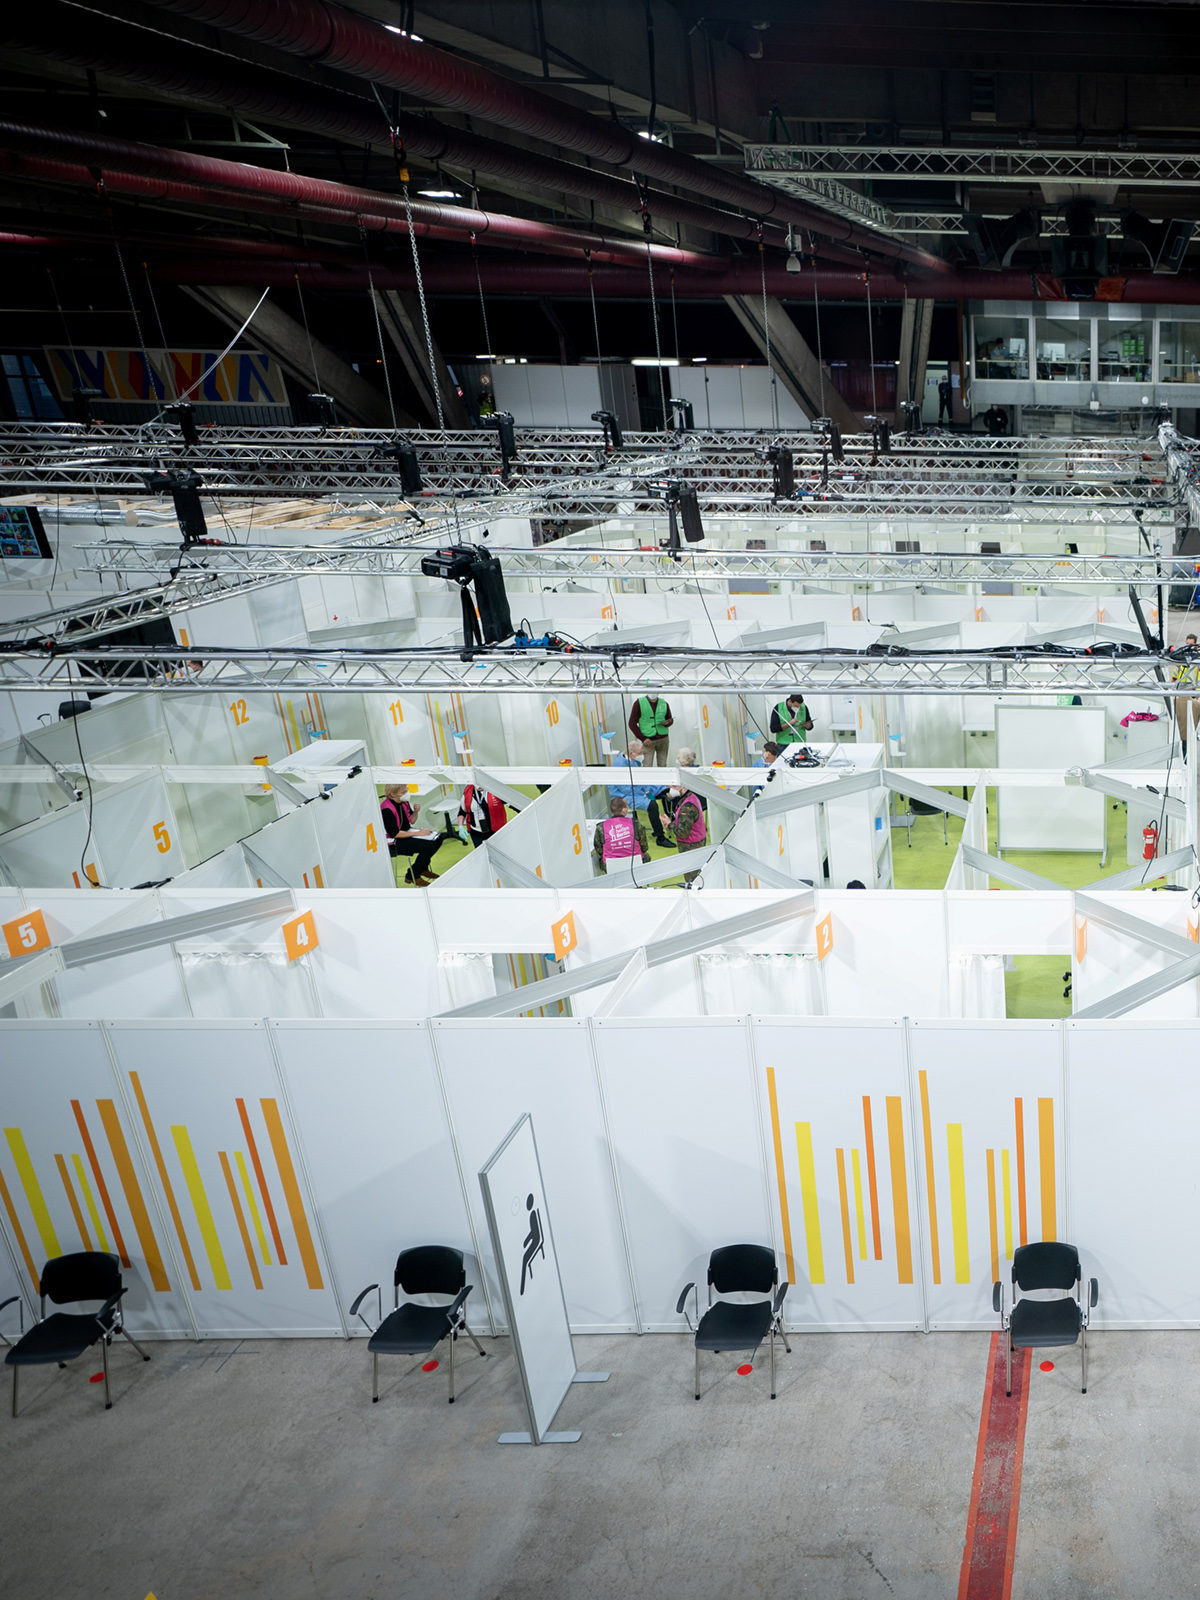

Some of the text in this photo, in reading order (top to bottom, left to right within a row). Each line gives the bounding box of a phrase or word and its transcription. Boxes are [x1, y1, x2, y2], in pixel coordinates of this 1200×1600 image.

[230, 698, 250, 726] 12
[389, 700, 404, 726] 11
[546, 700, 560, 728] 10
[702, 704, 709, 728] 9
[152, 820, 171, 854] 5
[366, 822, 378, 853] 4
[572, 824, 582, 855] 3
[778, 825, 785, 856] 2
[20, 922, 38, 948] 5
[296, 922, 308, 947] 4
[560, 923, 570, 948] 3
[822, 924, 829, 949] 2
